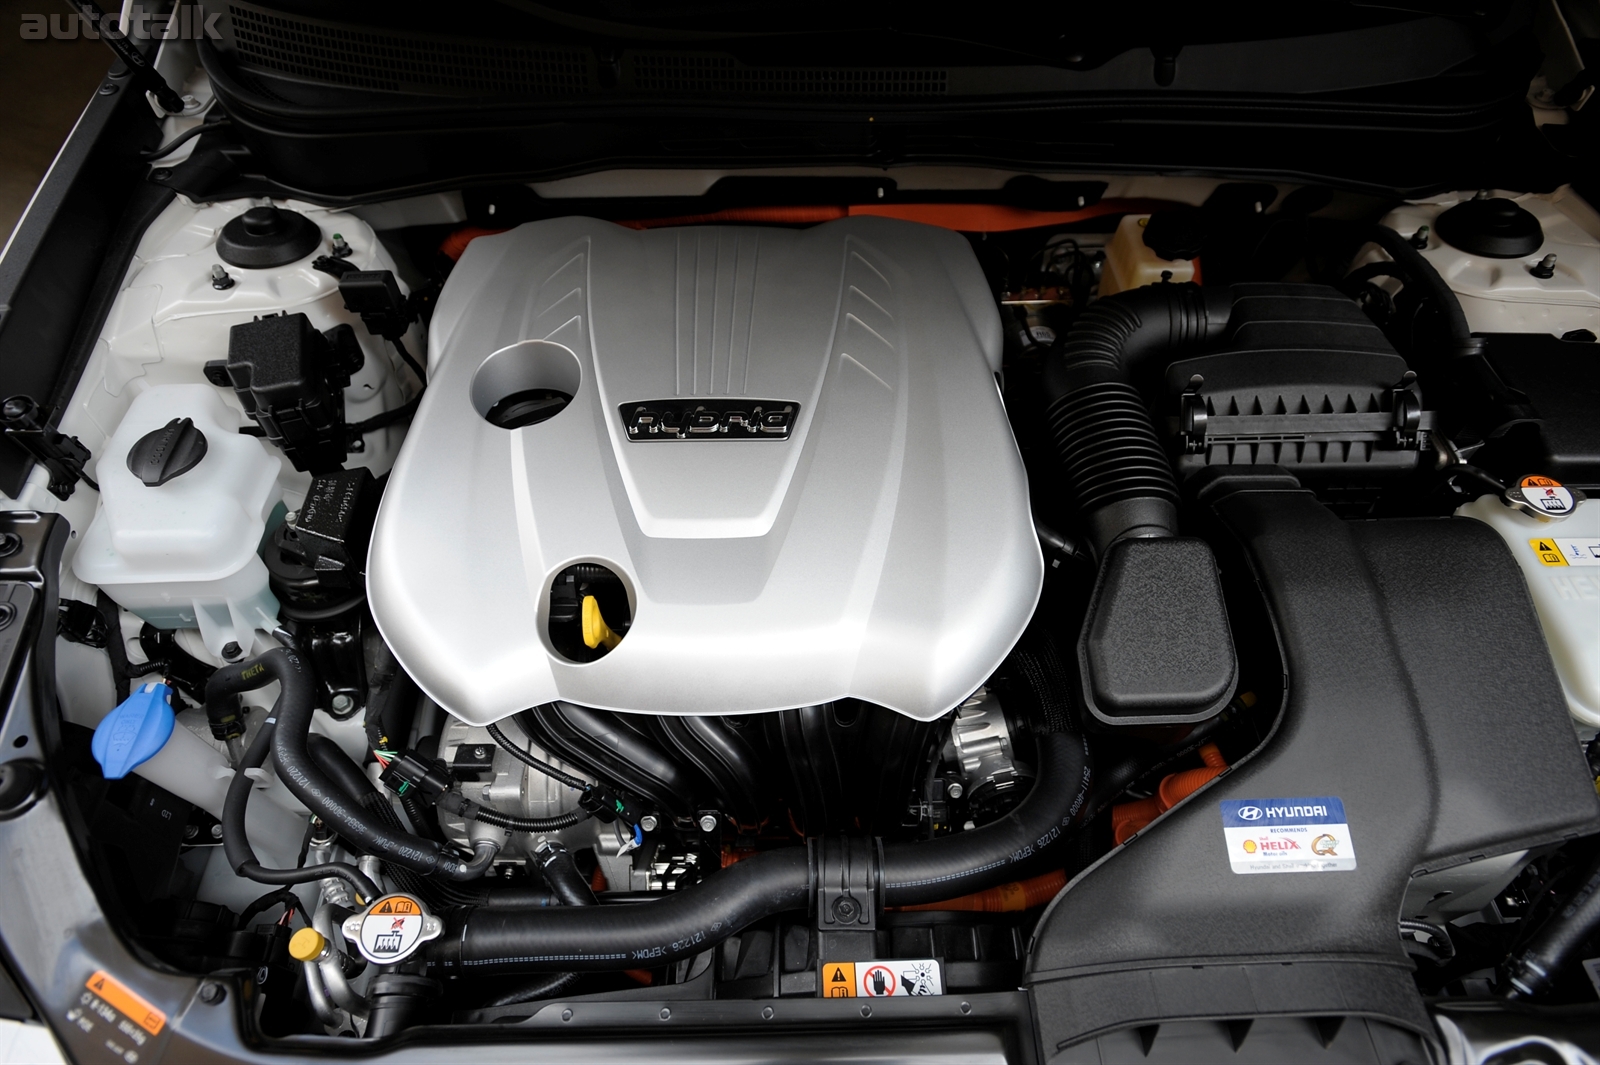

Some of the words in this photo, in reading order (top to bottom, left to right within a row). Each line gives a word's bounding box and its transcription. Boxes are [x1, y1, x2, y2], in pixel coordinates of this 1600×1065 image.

[629, 405, 793, 438] hybrid
[1265, 805, 1328, 818] HYUNDAI
[1260, 841, 1299, 851] HELIX
